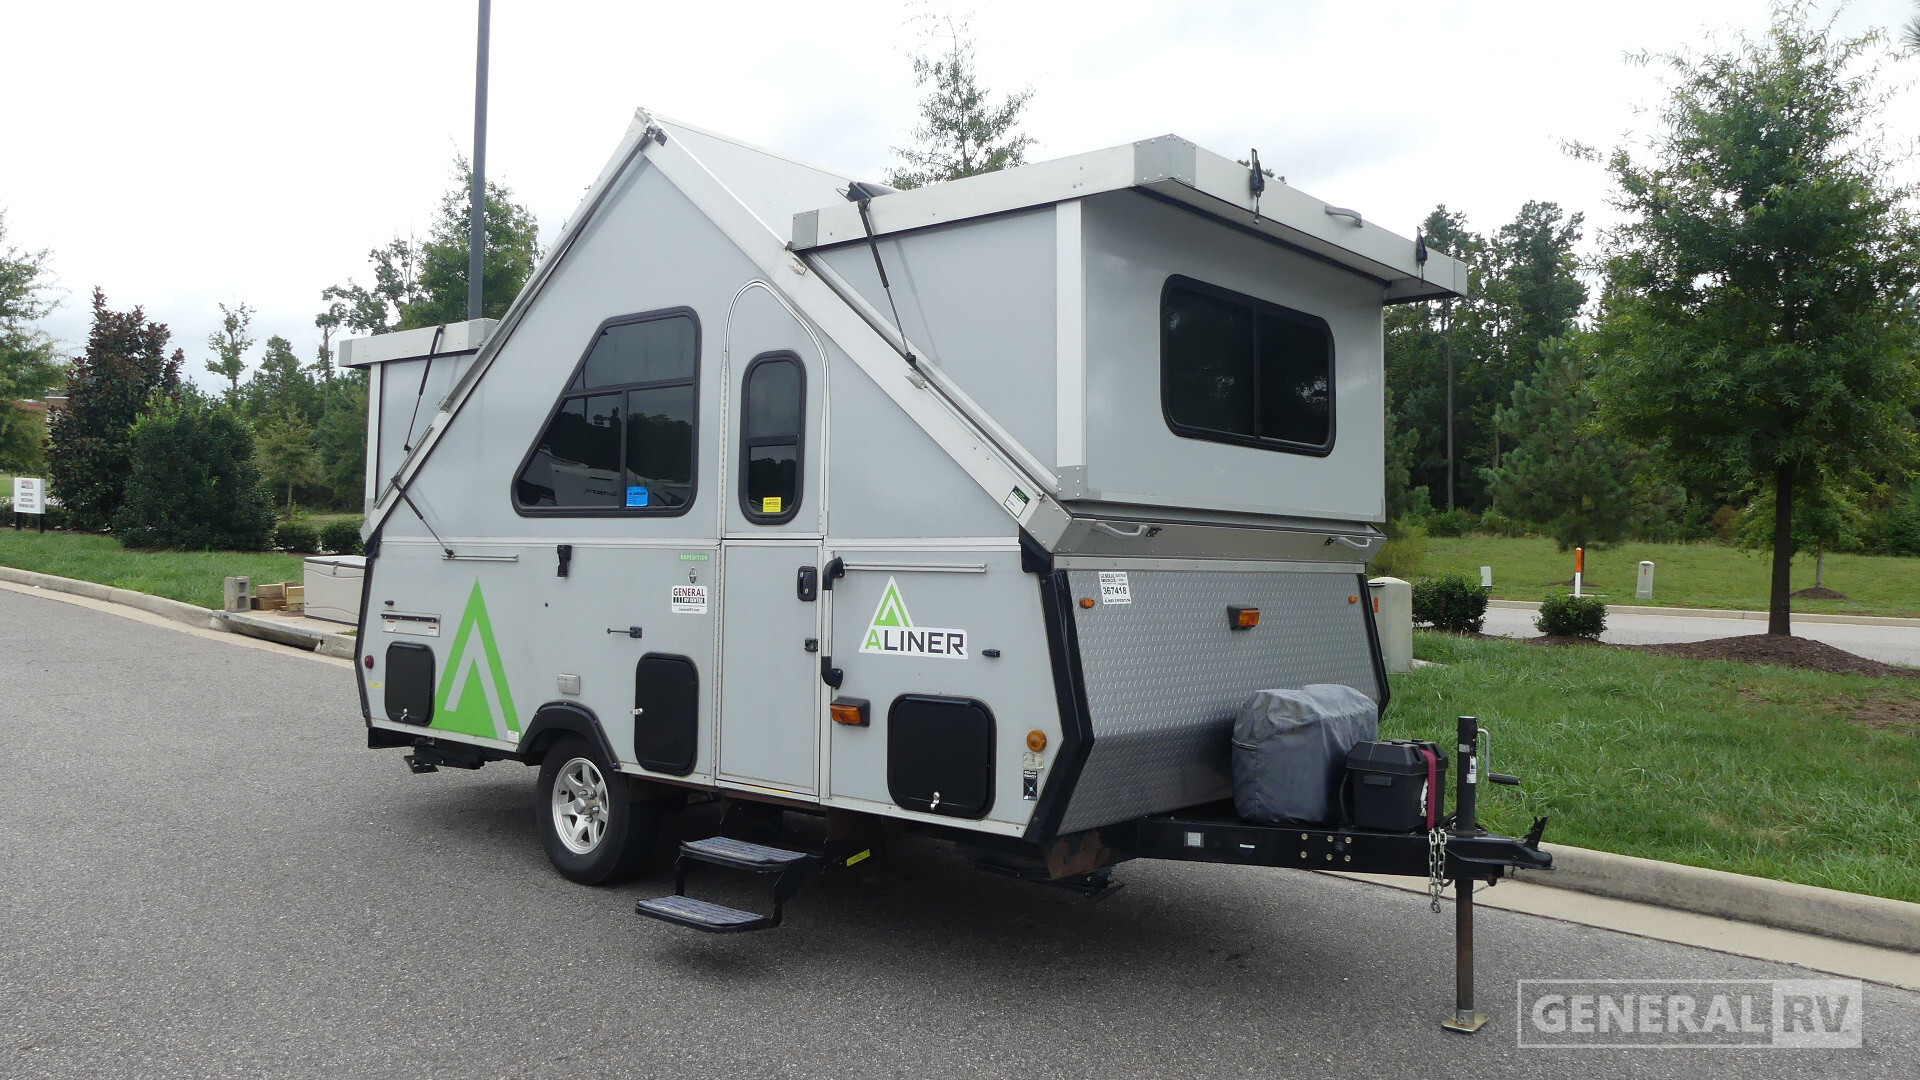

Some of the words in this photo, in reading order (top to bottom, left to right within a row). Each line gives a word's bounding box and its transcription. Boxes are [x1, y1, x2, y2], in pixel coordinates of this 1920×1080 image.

[673, 588, 705, 597] GENERAL
[1102, 586, 1127, 595] 367418
[865, 629, 964, 655] ALINER
